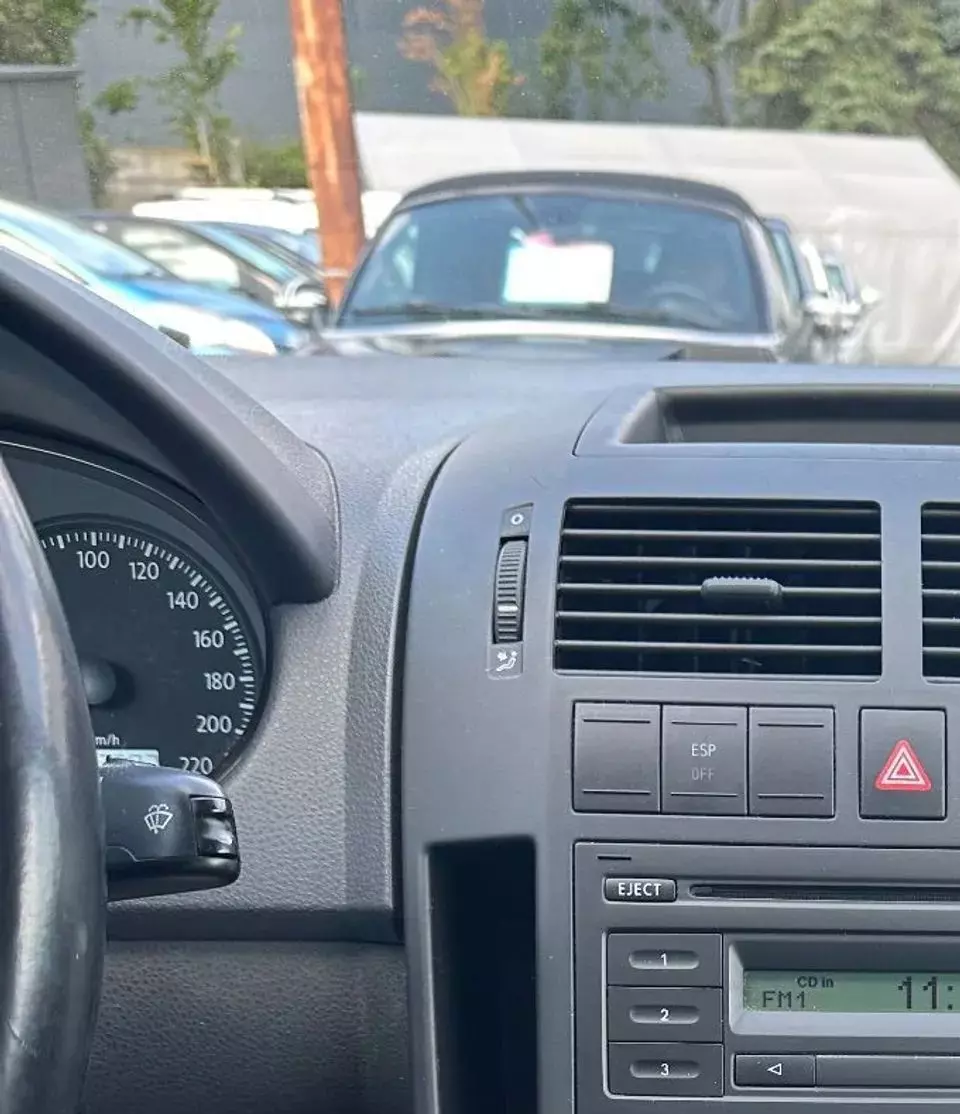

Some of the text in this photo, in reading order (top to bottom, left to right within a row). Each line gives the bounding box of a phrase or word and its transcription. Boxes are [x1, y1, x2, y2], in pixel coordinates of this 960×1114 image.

[77, 551, 109, 568] 100
[129, 562, 159, 580] 120
[167, 592, 199, 609] 140
[193, 630, 224, 648] 160
[204, 673, 235, 690] 180
[196, 715, 232, 733] 200
[691, 743, 716, 757] ESP
[179, 757, 213, 775] 220
[691, 768, 715, 781] OFF
[618, 882, 662, 897] EJECT
[660, 953, 668, 966] 1
[797, 976, 818, 989] CD
[762, 990, 806, 1008] FM1
[660, 1008, 670, 1022] 2
[660, 1063, 670, 1076] 3
